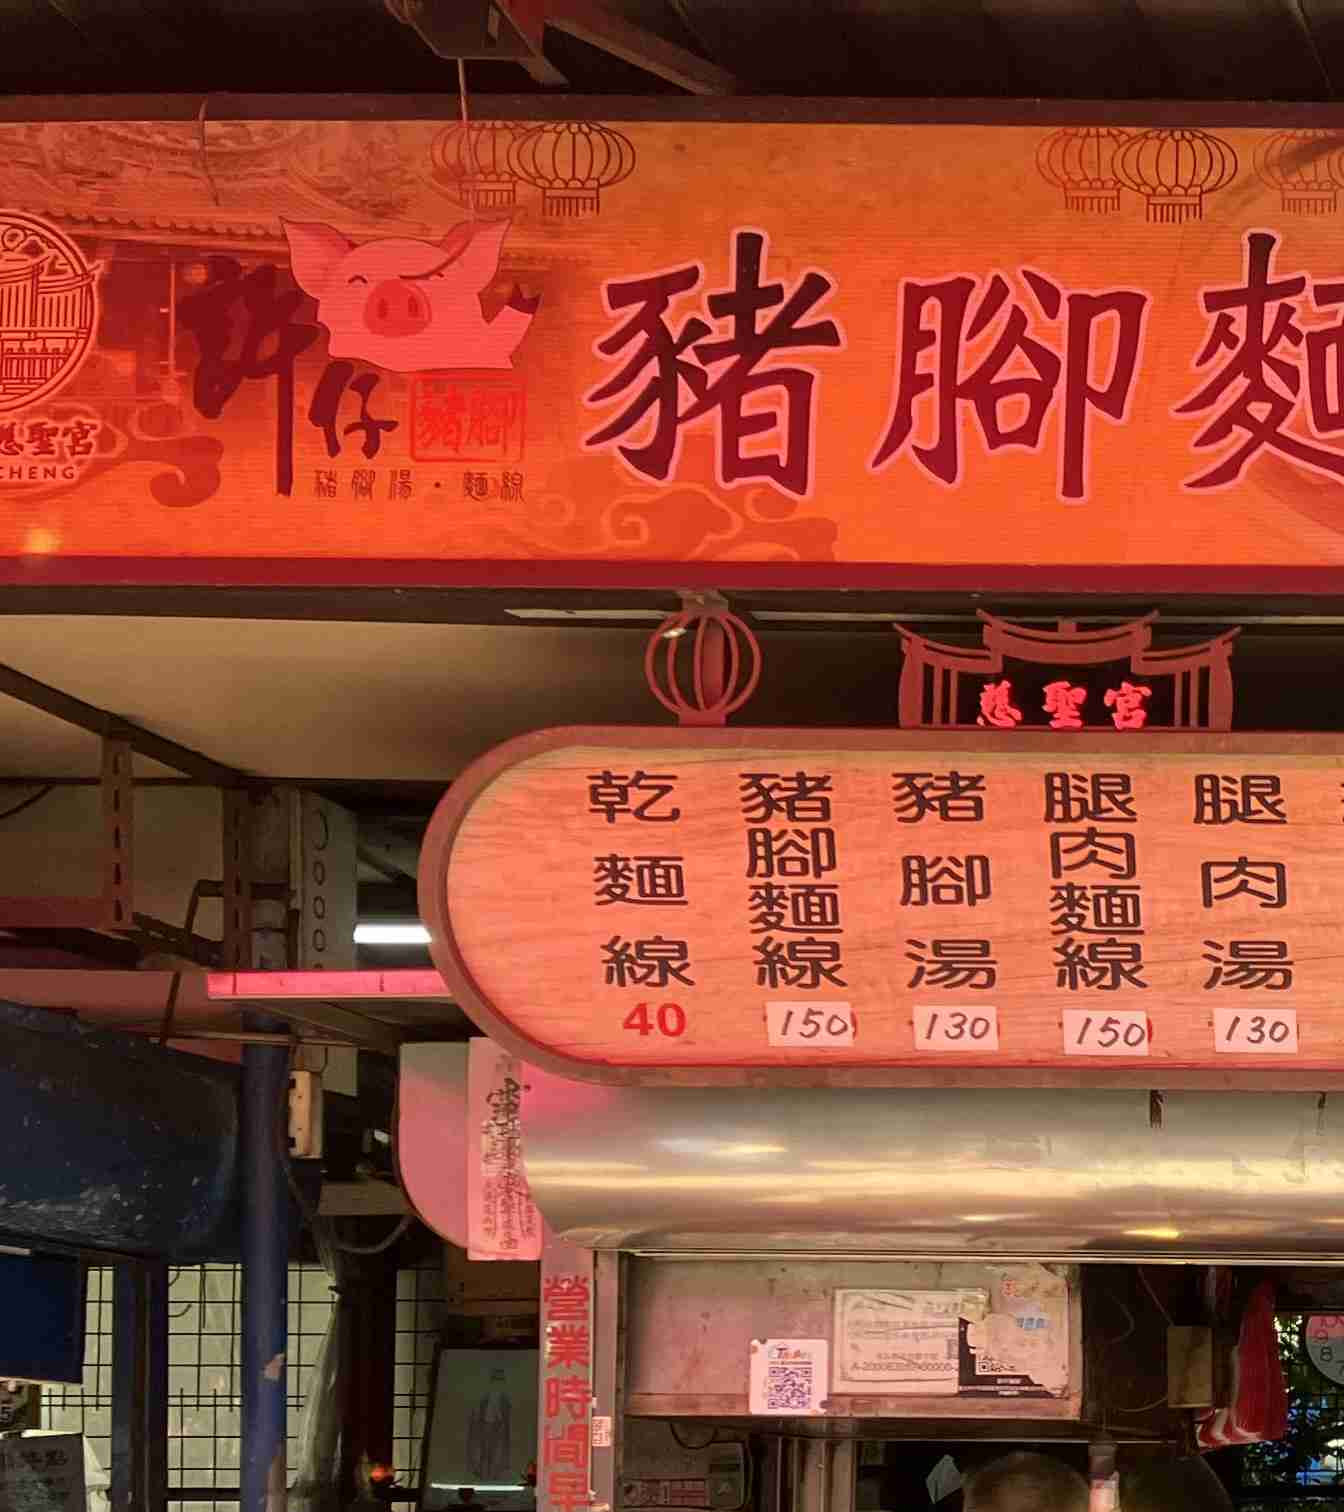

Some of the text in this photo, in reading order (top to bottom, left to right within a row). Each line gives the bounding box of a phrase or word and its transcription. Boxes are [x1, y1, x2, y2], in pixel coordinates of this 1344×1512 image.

[977, 681, 1152, 729] 慈聖宮
[587, 770, 696, 988] 乾麵線
[739, 771, 848, 989] 豬腳麵線
[892, 771, 997, 990] 豬腳湯
[1044, 772, 1148, 991] 腿肉麵線
[1192, 774, 1294, 991] 腿肉湯
[623, 1003, 687, 1036] 40
[778, 1008, 849, 1038] 150
[925, 1010, 990, 1040] 130
[1075, 1016, 1146, 1048] 150
[1224, 1015, 1290, 1045] 130
